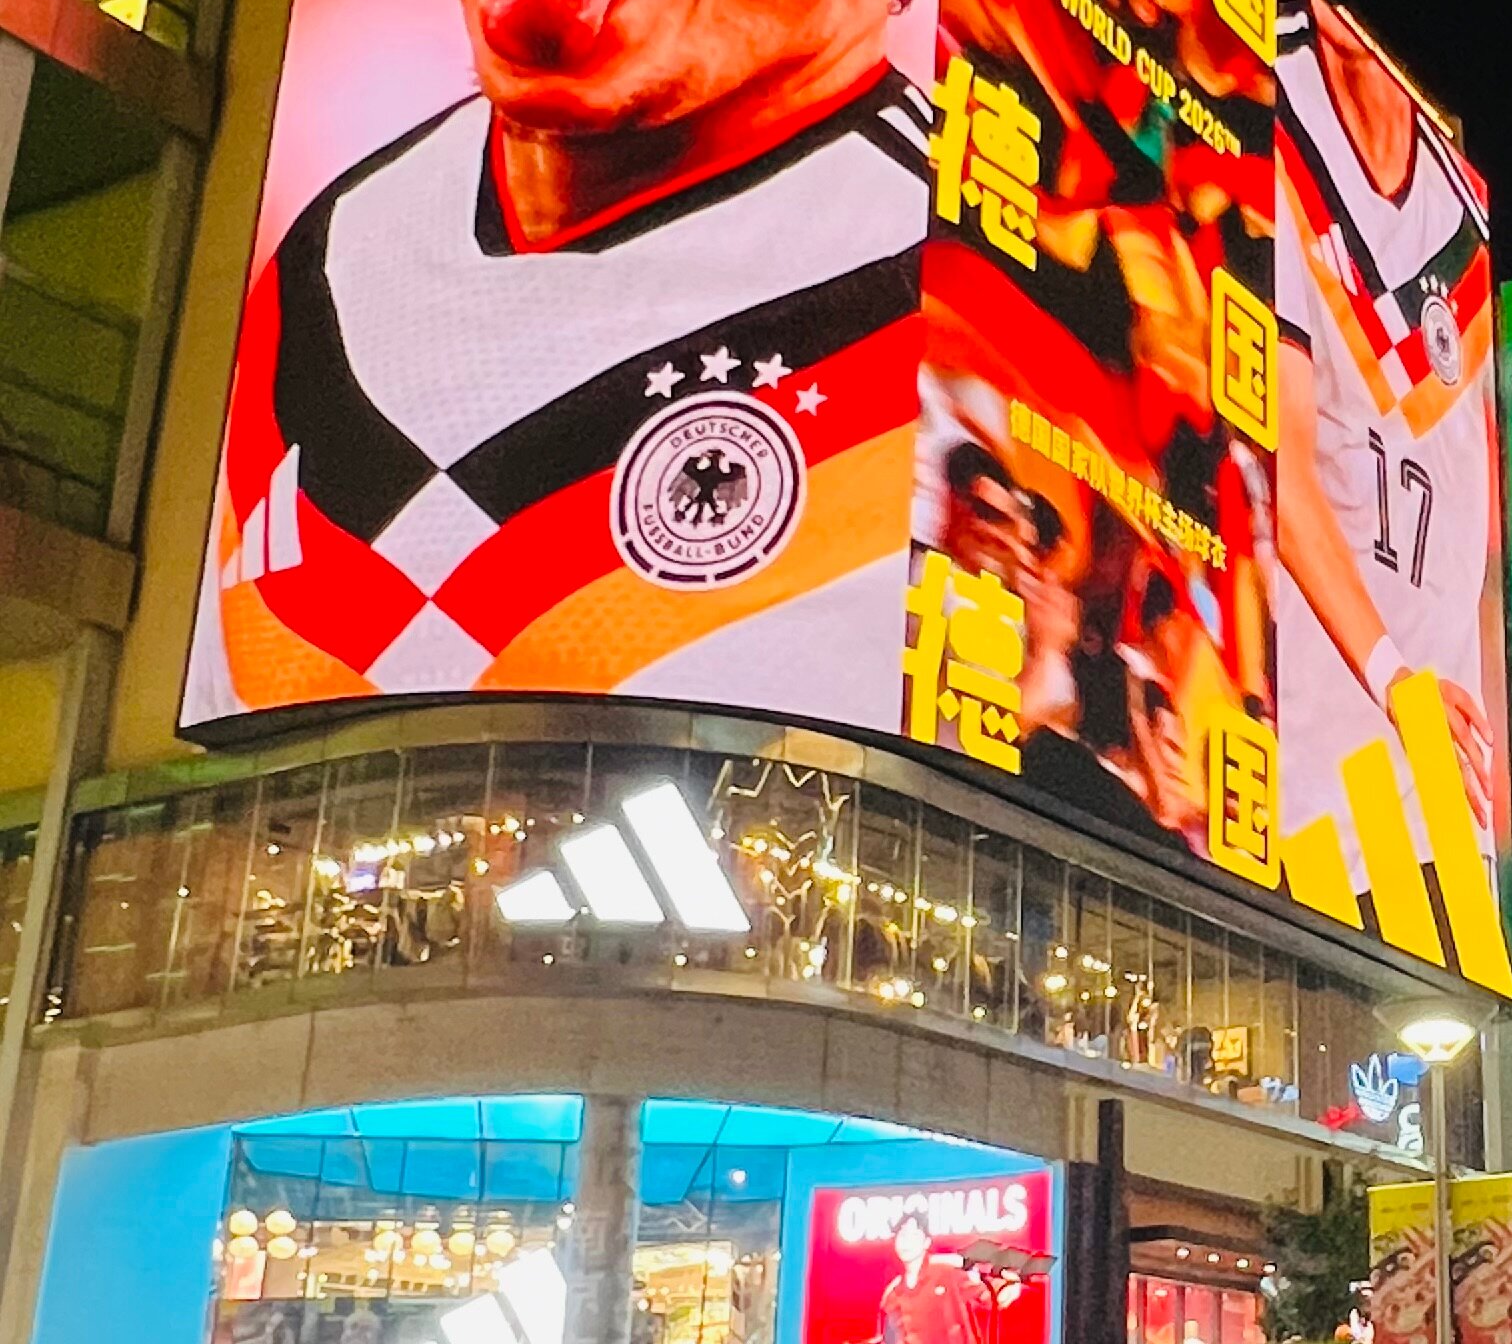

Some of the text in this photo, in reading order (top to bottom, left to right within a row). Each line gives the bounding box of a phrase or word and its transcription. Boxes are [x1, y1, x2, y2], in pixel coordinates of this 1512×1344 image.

[1136, 47, 1176, 104] CUP
[928, 55, 1278, 452] 德 国
[669, 422, 769, 459] DEUTSCHER
[1368, 427, 1431, 587] 17
[903, 550, 1281, 890] 德 国
